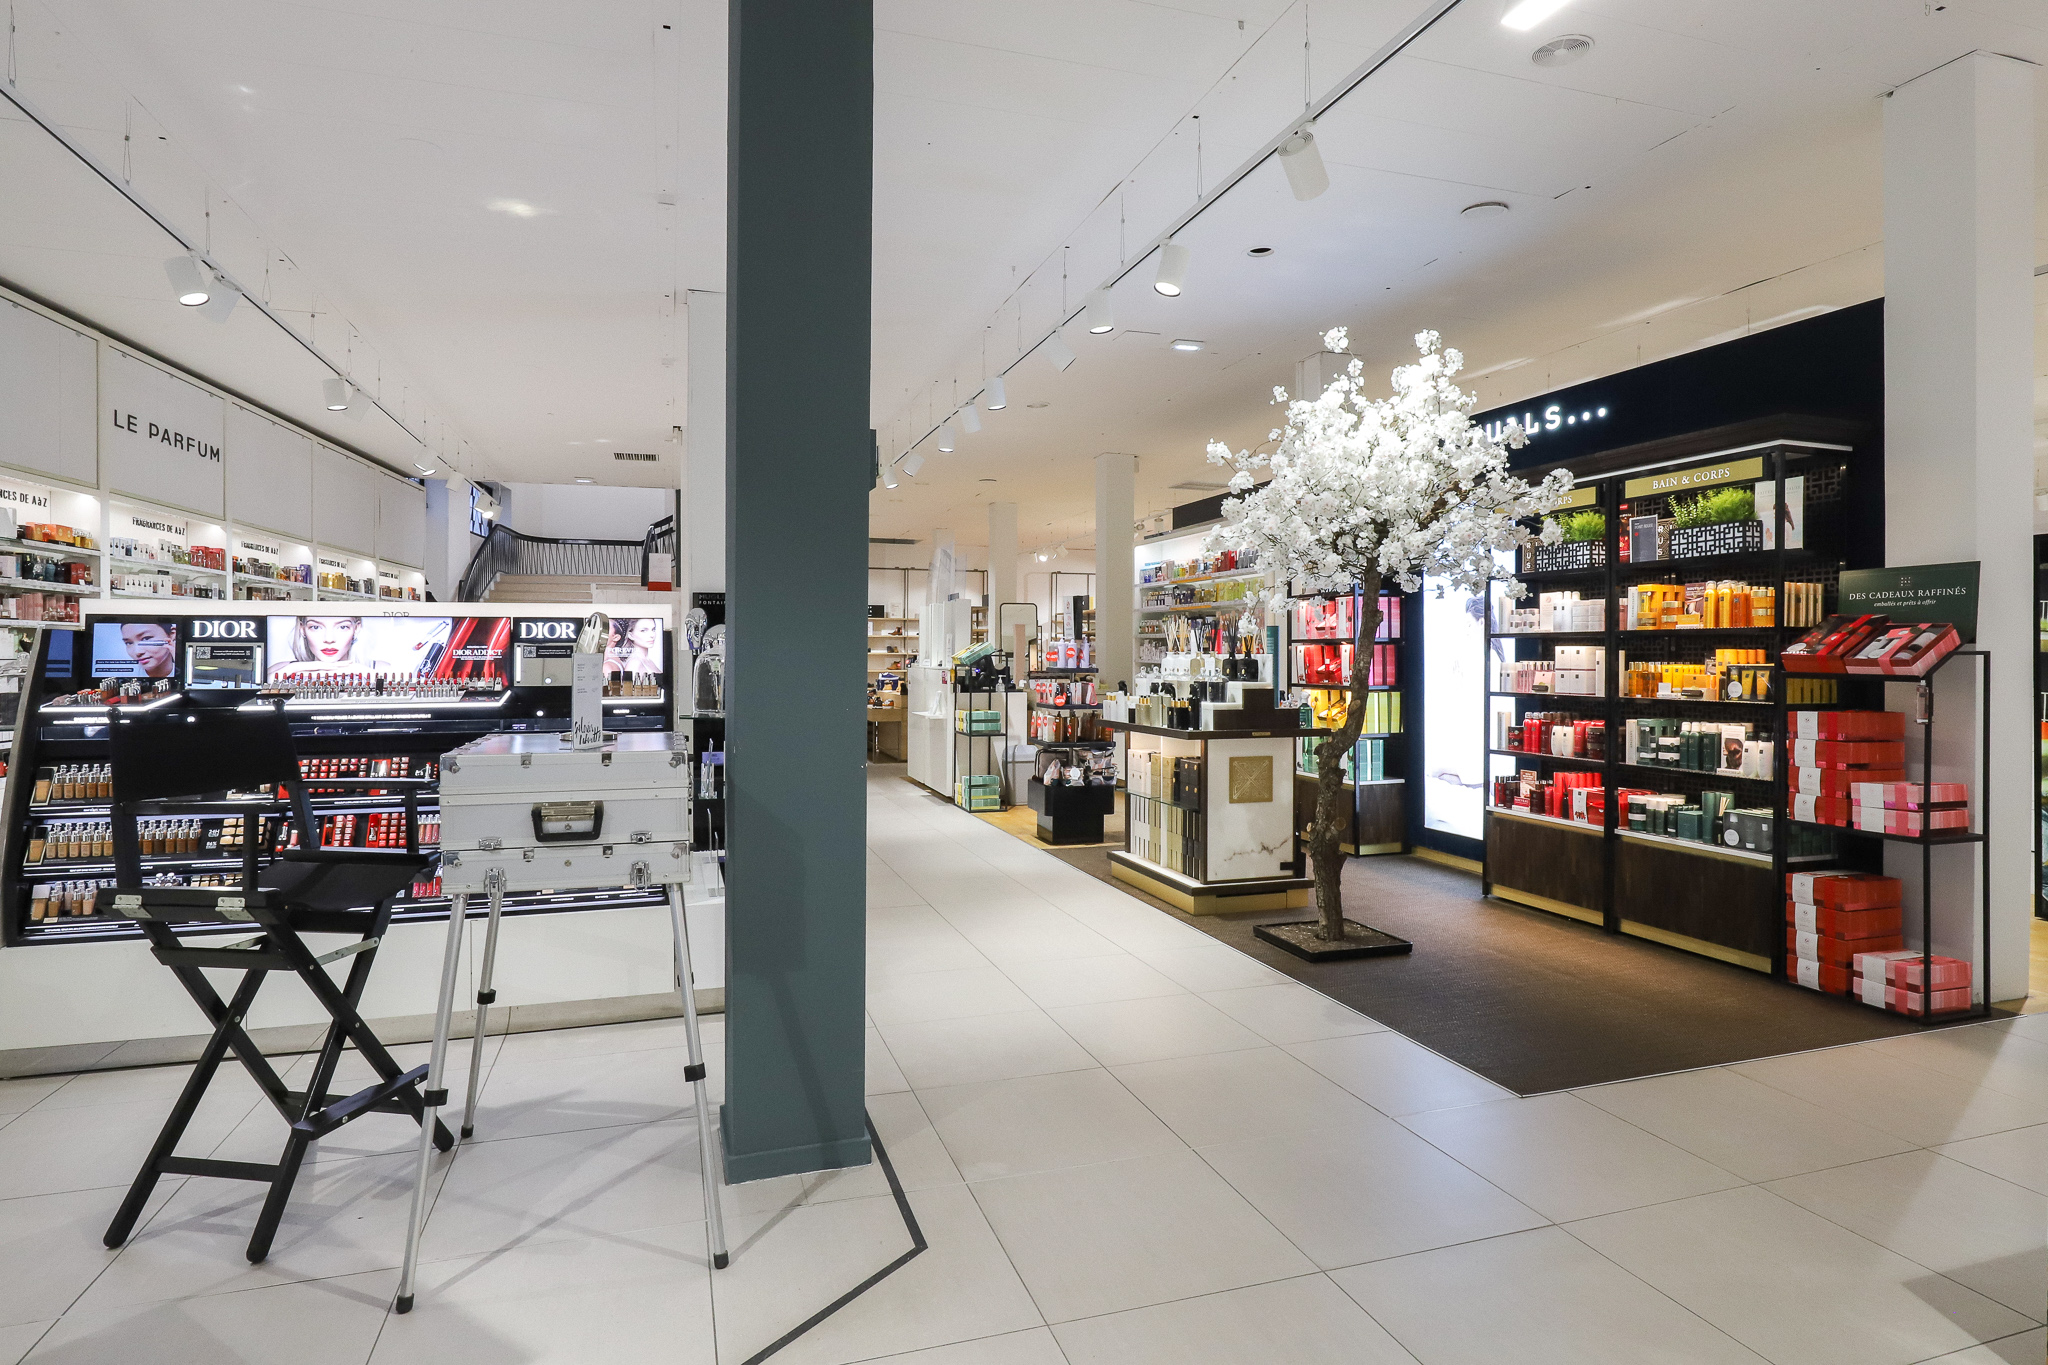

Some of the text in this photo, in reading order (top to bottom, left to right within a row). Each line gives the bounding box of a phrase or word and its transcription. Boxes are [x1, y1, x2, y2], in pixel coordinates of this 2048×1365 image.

[114, 409, 220, 463] LE PARFUM
[1652, 468, 1730, 490] BAIN & CORPS
[19, 492, 29, 504] DE
[32, 496, 37, 505] A
[43, 498, 48, 507] Z
[132, 516, 165, 531] FRAGRANCES
[166, 525, 173, 533] DE
[1869, 590, 1914, 599] CADEAUX
[1918, 586, 1967, 597] RAFFINÉS
[192, 620, 257, 638] DIOR
[520, 622, 577, 639] DIOR
